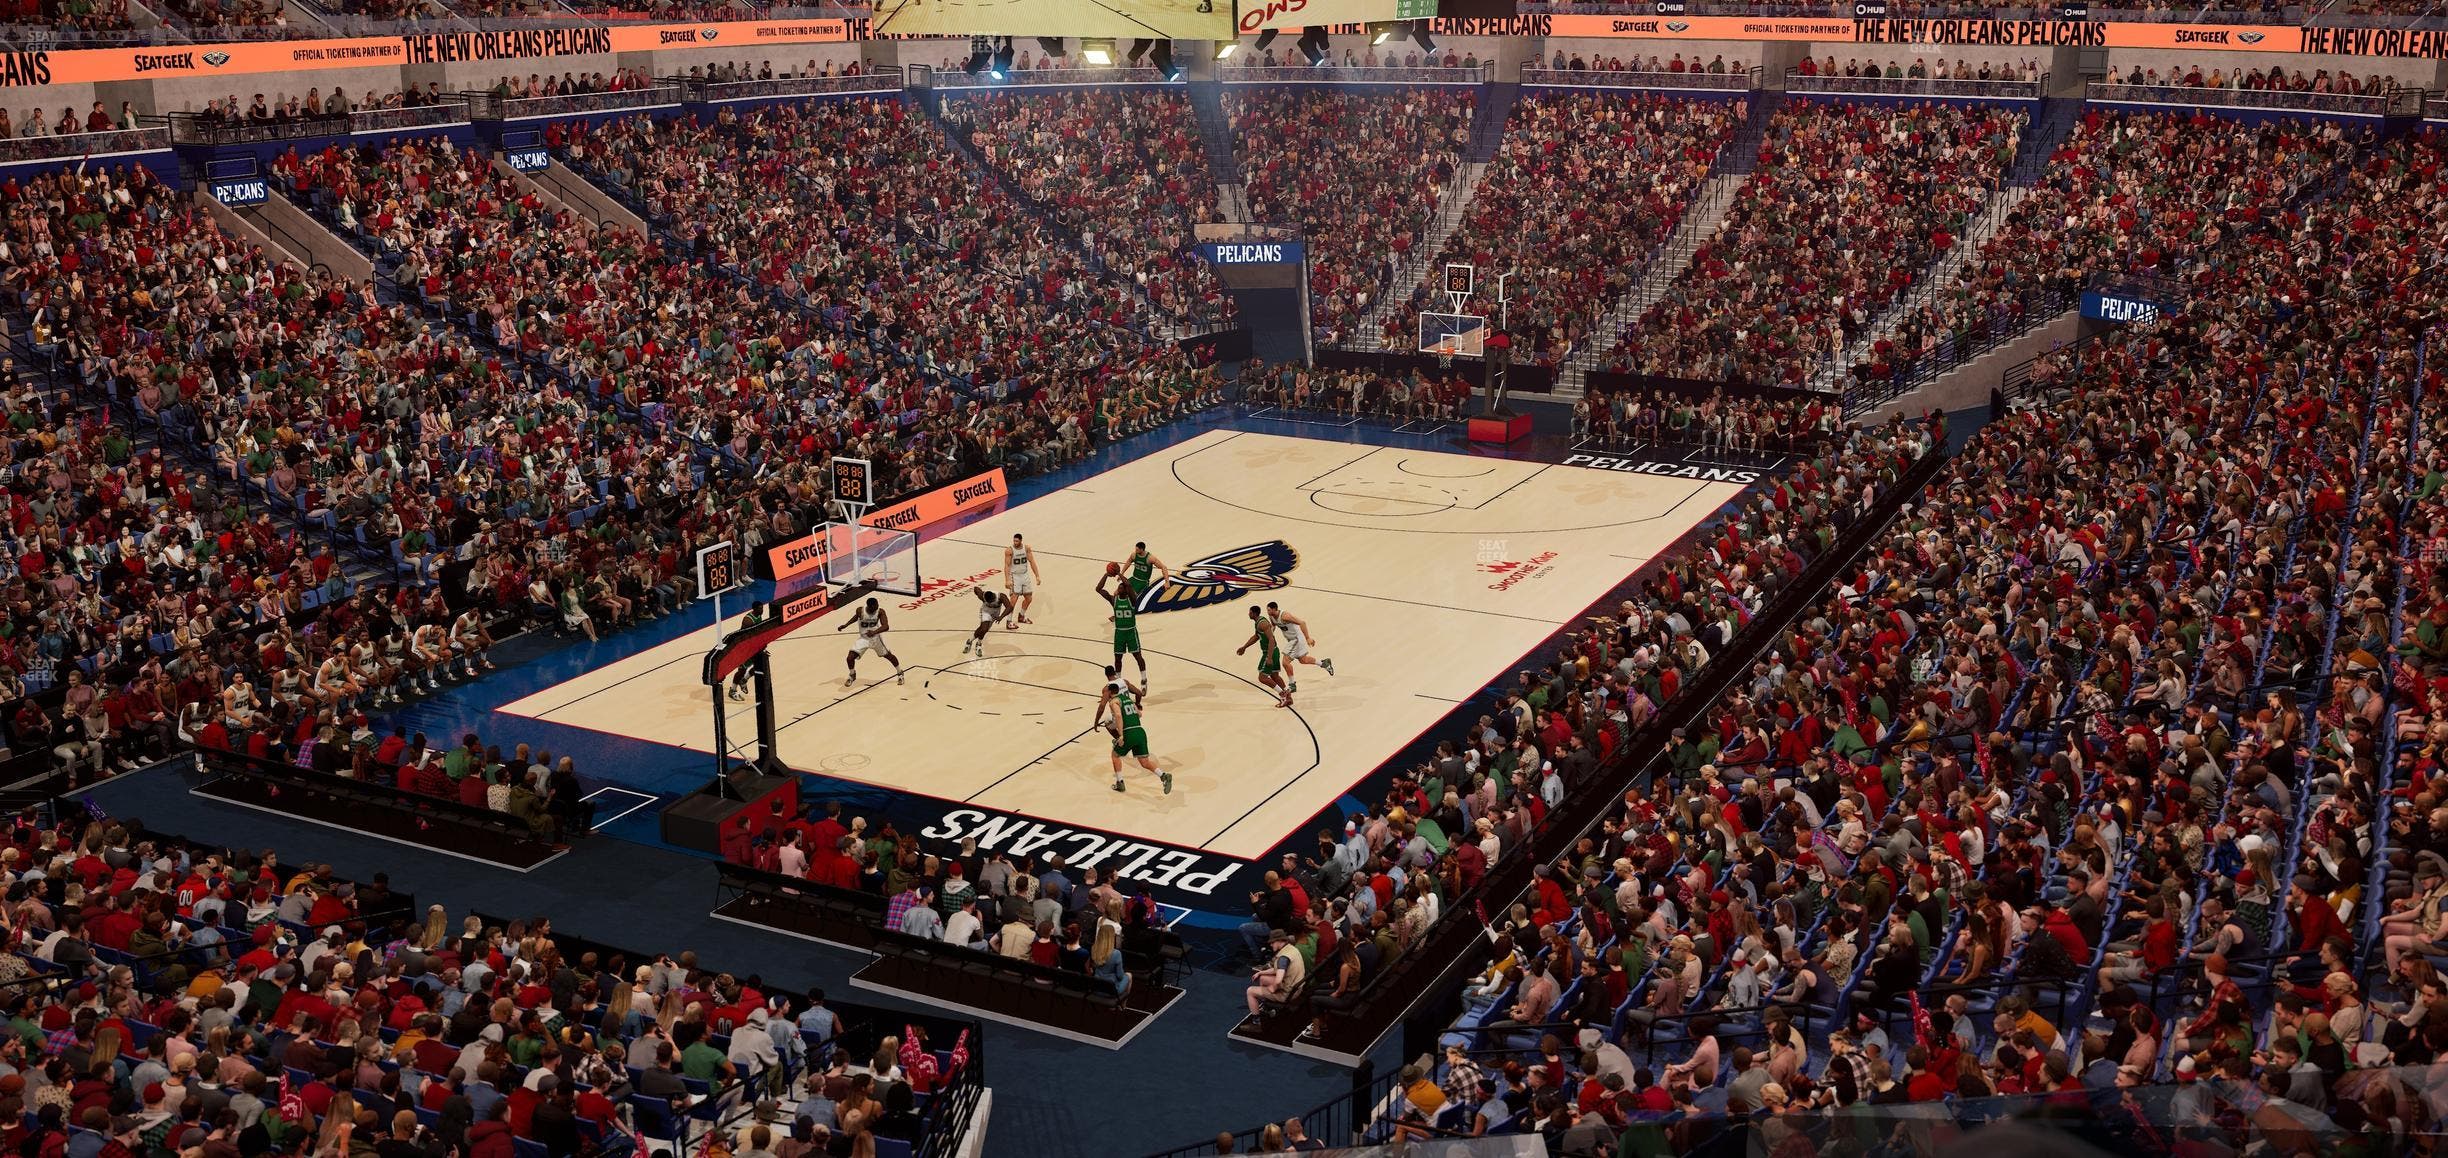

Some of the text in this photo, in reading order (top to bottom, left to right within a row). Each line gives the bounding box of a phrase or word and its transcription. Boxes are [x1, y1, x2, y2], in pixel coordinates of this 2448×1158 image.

[660, 29, 697, 44] SEATGEEK
[756, 27, 777, 37] OFFICIAL
[778, 26, 808, 36] TICKETING
[809, 25, 834, 35] PARTNER
[835, 25, 842, 34] OF
[843, 18, 870, 41] THE
[1479, 14, 1552, 36] PELICANS
[1612, 20, 1659, 33] SEATGEEK
[1744, 18, 2106, 47] OFFICIAL TICKETING PARTNER OF THE NEW ORLEANS PELICANS
[2174, 29, 2230, 45] SEATGEEK
[293, 27, 611, 64] OFFICIAL TICKETING PARTNER OF THE NEW ORLEANS PELICANS
[2300, 27, 2331, 54] THE
[2332, 28, 2372, 55] NEW
[134, 52, 195, 73] SEATGEEK
[216, 182, 265, 203] PELICANS
[1217, 244, 1282, 263] PELICANS
[1561, 454, 1761, 484] PELICANS
[952, 477, 996, 506] SEATGEEK
[873, 504, 921, 534] SEATGEEK
[785, 534, 837, 568] SEATGEEK
[786, 594, 824, 619] SEATGEEK
[898, 581, 970, 611] SMOOTHIE
[920, 808, 1243, 895] PELICANS
[179, 889, 194, 907] 00
